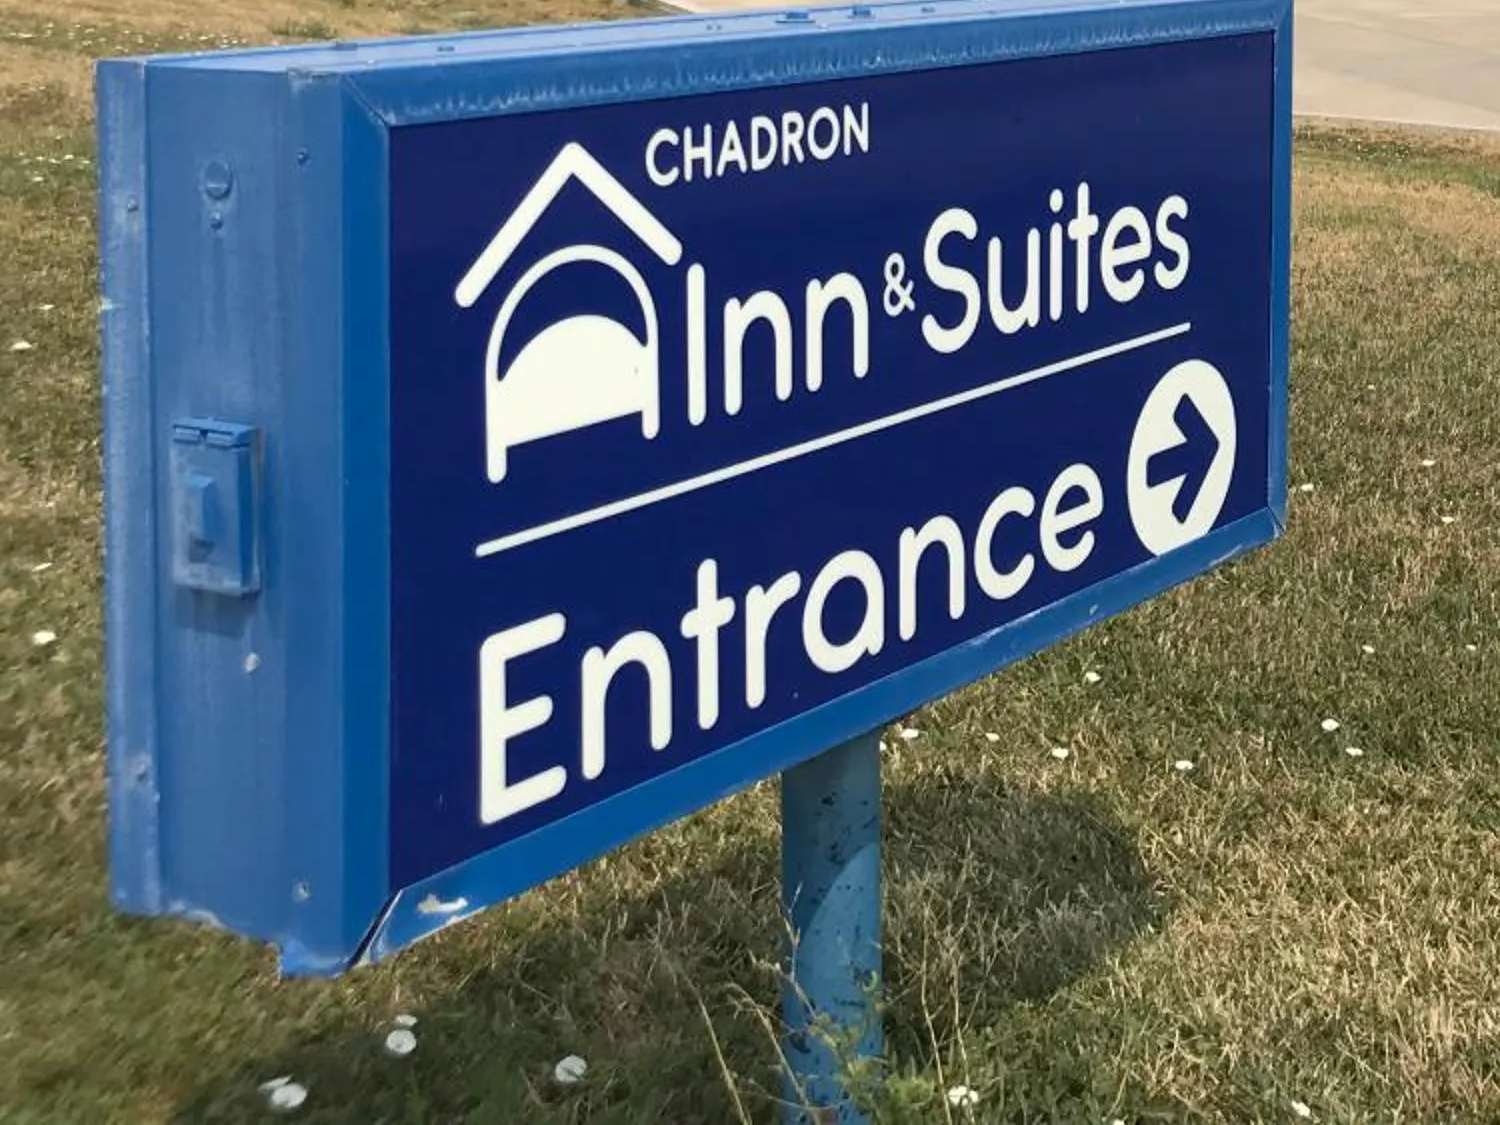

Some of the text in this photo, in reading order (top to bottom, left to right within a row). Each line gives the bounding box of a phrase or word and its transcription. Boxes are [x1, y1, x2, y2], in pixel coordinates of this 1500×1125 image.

[645, 102, 870, 186] CHADRON
[686, 181, 1190, 427] Inn & Suites
[479, 462, 1104, 825] Entrance
